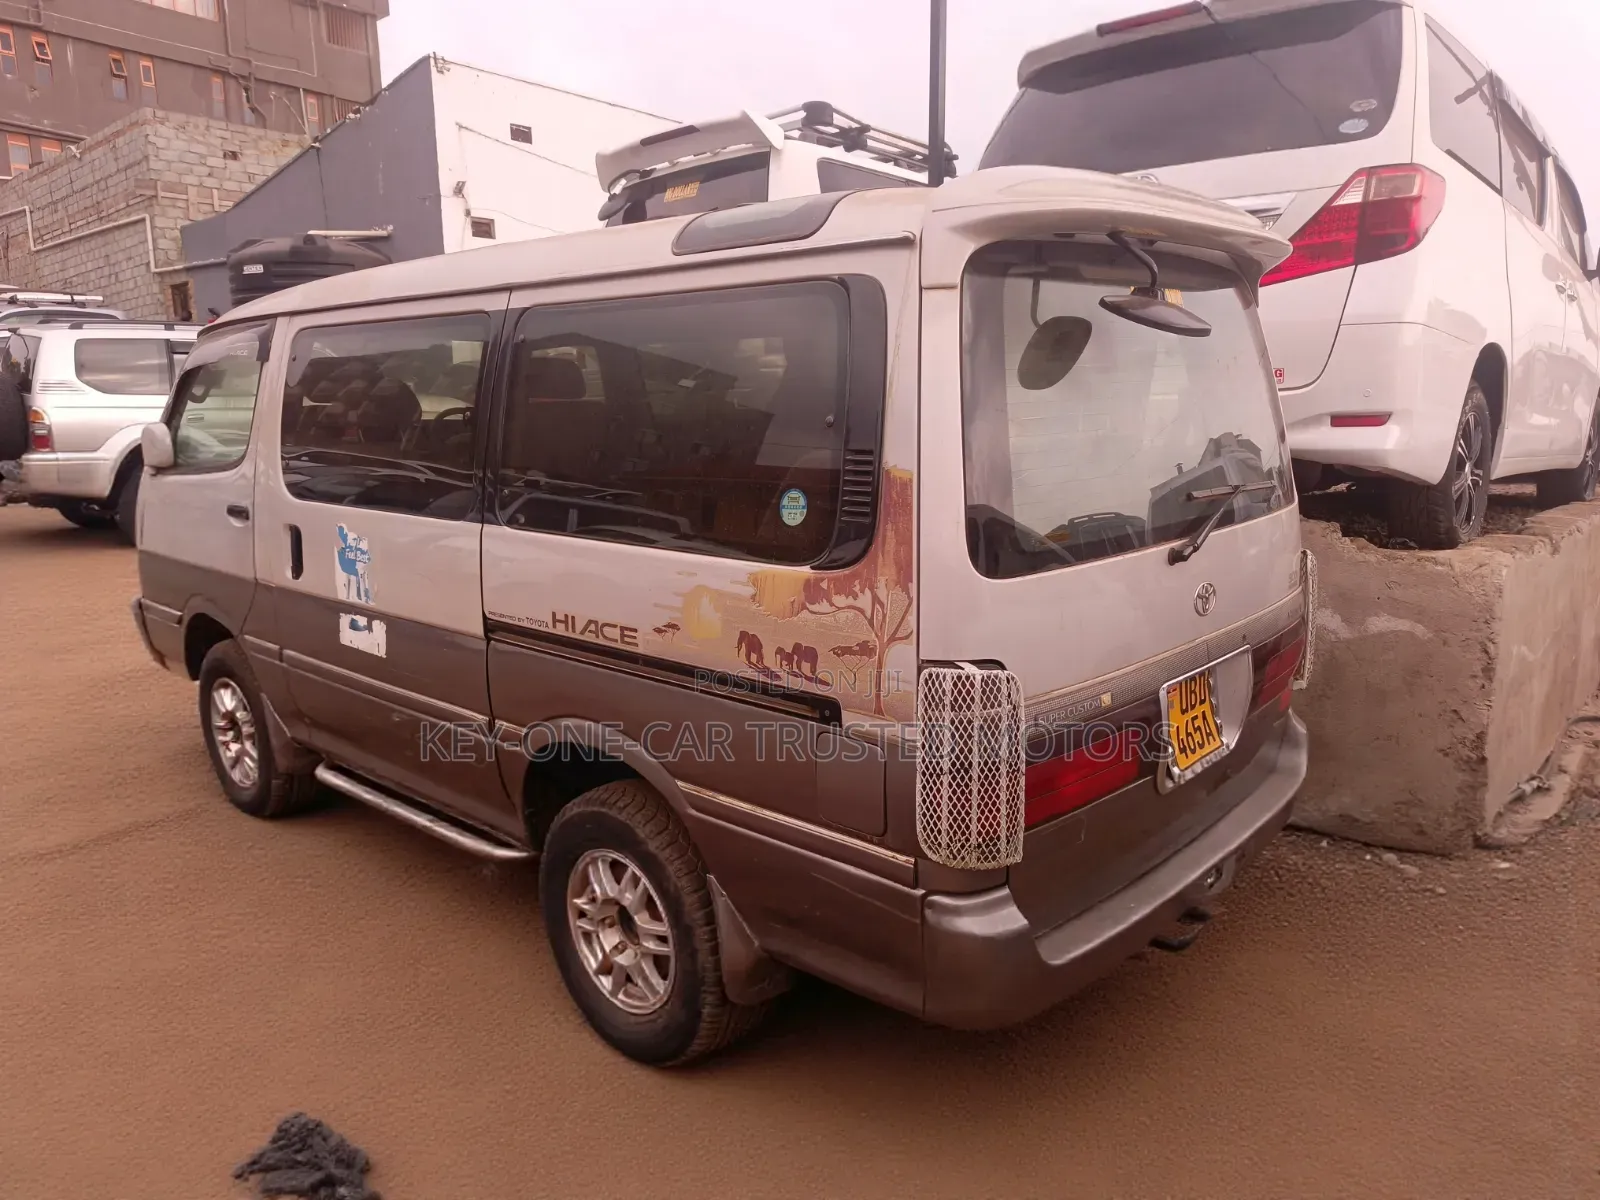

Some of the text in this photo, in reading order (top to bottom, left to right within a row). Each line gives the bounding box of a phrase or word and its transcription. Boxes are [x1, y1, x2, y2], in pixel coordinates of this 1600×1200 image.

[526, 617, 549, 629] TOYOTA
[552, 611, 639, 647] HIACE
[1039, 710, 1066, 725] SUPER
[1067, 699, 1100, 718] CUSTOM
[1176, 710, 1217, 760] 465A
